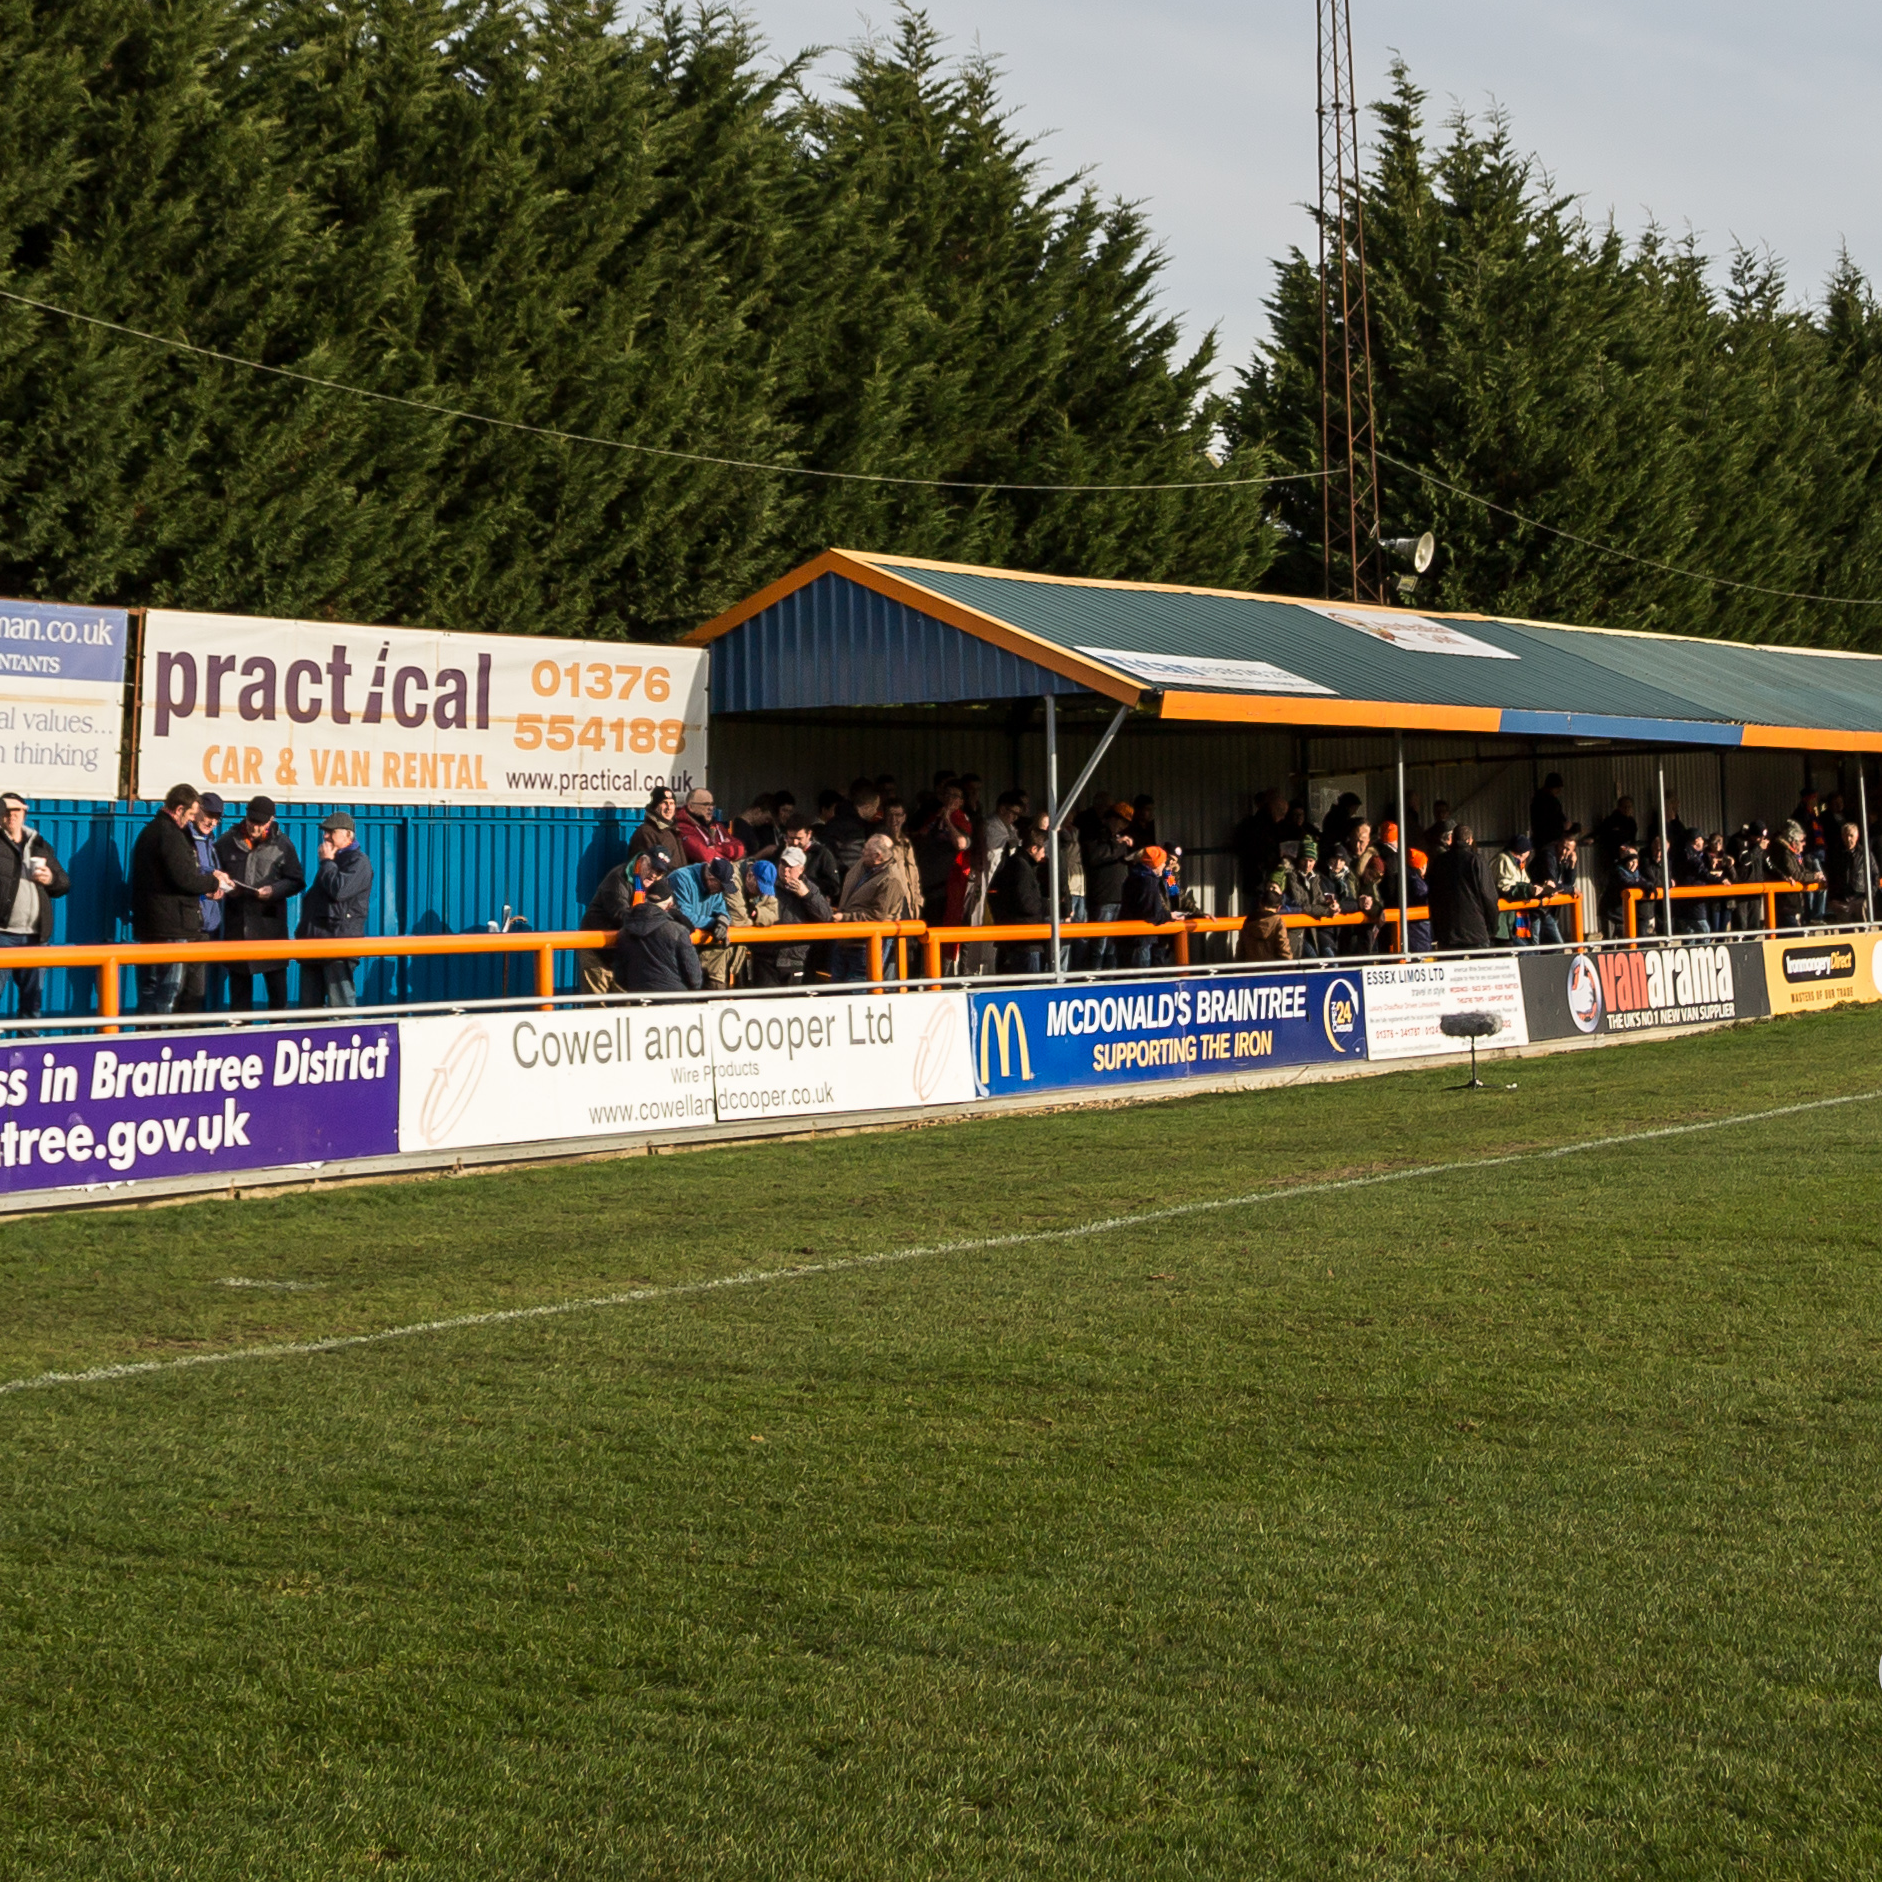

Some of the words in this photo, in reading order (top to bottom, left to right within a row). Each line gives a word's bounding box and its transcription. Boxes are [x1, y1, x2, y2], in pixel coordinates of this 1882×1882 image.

[153, 640, 492, 737] practical
[531, 659, 671, 703] 01376
[513, 713, 686, 755] 554188
[14, 741, 99, 773] thinking
[202, 745, 263, 785] CAR
[275, 747, 299, 786] &
[309, 748, 370, 787] VAN
[382, 751, 489, 790] RENTAL
[1367, 971, 1396, 985] ESSEX
[1398, 969, 1426, 983] LIMOS
[1428, 968, 1445, 981] LTD
[1597, 945, 1735, 1013] vanarama
[1786, 950, 1852, 976] IronmongeryDirect
[1046, 991, 1192, 1037] MCDONALD'S
[1196, 985, 1307, 1024] BRAINTREE
[1336, 1000, 1353, 1025] 24
[1411, 988, 1427, 997] travel
[1433, 987, 1445, 997] style
[1790, 991, 1815, 1004] MASTERS
[1816, 990, 1824, 1001] OF
[1824, 988, 1836, 1000] OUR
[1837, 986, 1854, 999] TRADE
[513, 1018, 632, 1069] Cowell
[644, 1011, 707, 1063] and
[719, 1003, 836, 1061] Cooper
[848, 1003, 895, 1046] Ltd
[1607, 1014, 1624, 1030] THE
[1660, 1008, 1681, 1025] NEW
[1681, 1006, 1700, 1023] VAN
[1699, 1002, 1736, 1021] SUPPLIER
[40, 1053, 78, 1105] in
[89, 1043, 264, 1100] Braintree
[272, 1036, 391, 1089] District
[1092, 1035, 1197, 1072] SUPPORTING
[1199, 1032, 1231, 1060] THE
[1234, 1030, 1273, 1058] IRON
[671, 1067, 700, 1084] Wire
[703, 1061, 760, 1082] Products
[589, 1081, 835, 1125] www.cowellandcooper.co.uk
